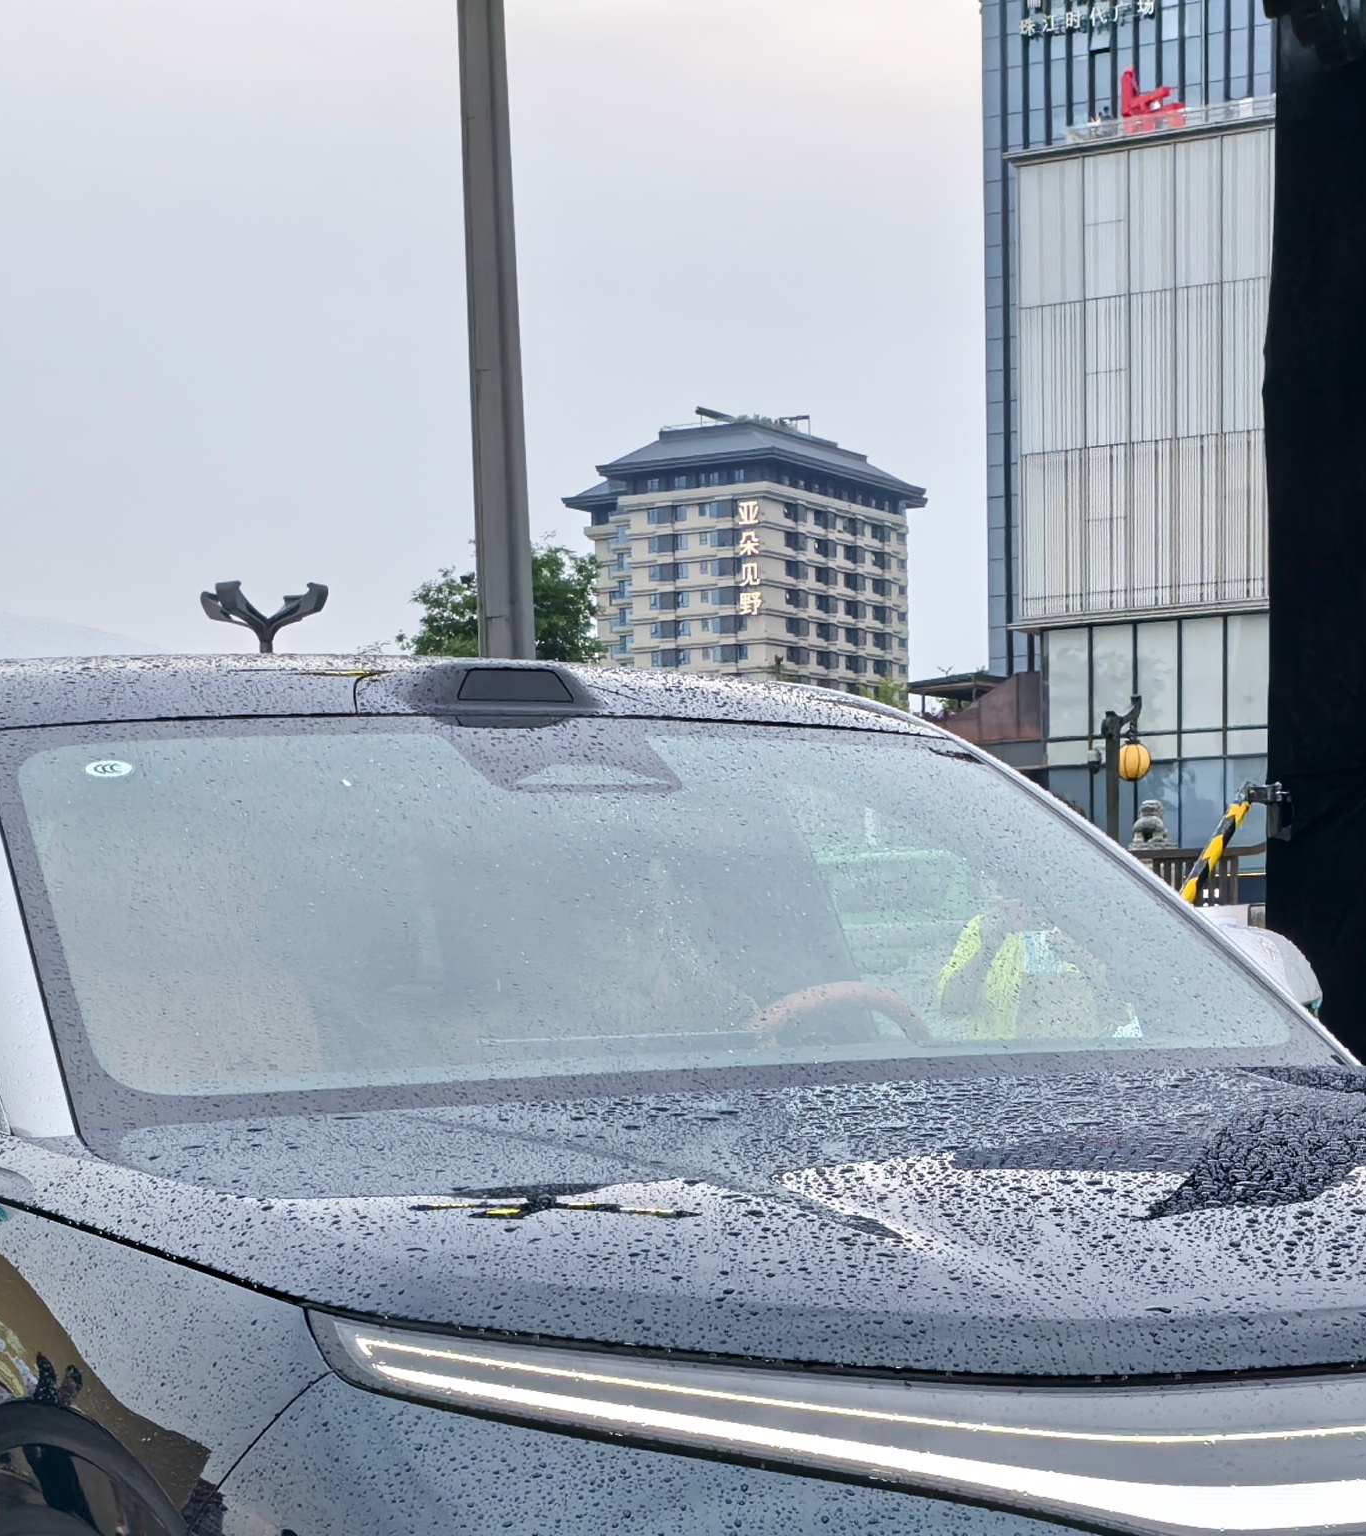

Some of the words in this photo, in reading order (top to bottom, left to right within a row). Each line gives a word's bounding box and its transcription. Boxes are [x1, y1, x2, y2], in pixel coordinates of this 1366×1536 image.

[1020, 0, 1155, 36] 珠江时代广场
[738, 500, 762, 616] 亚朵见野
